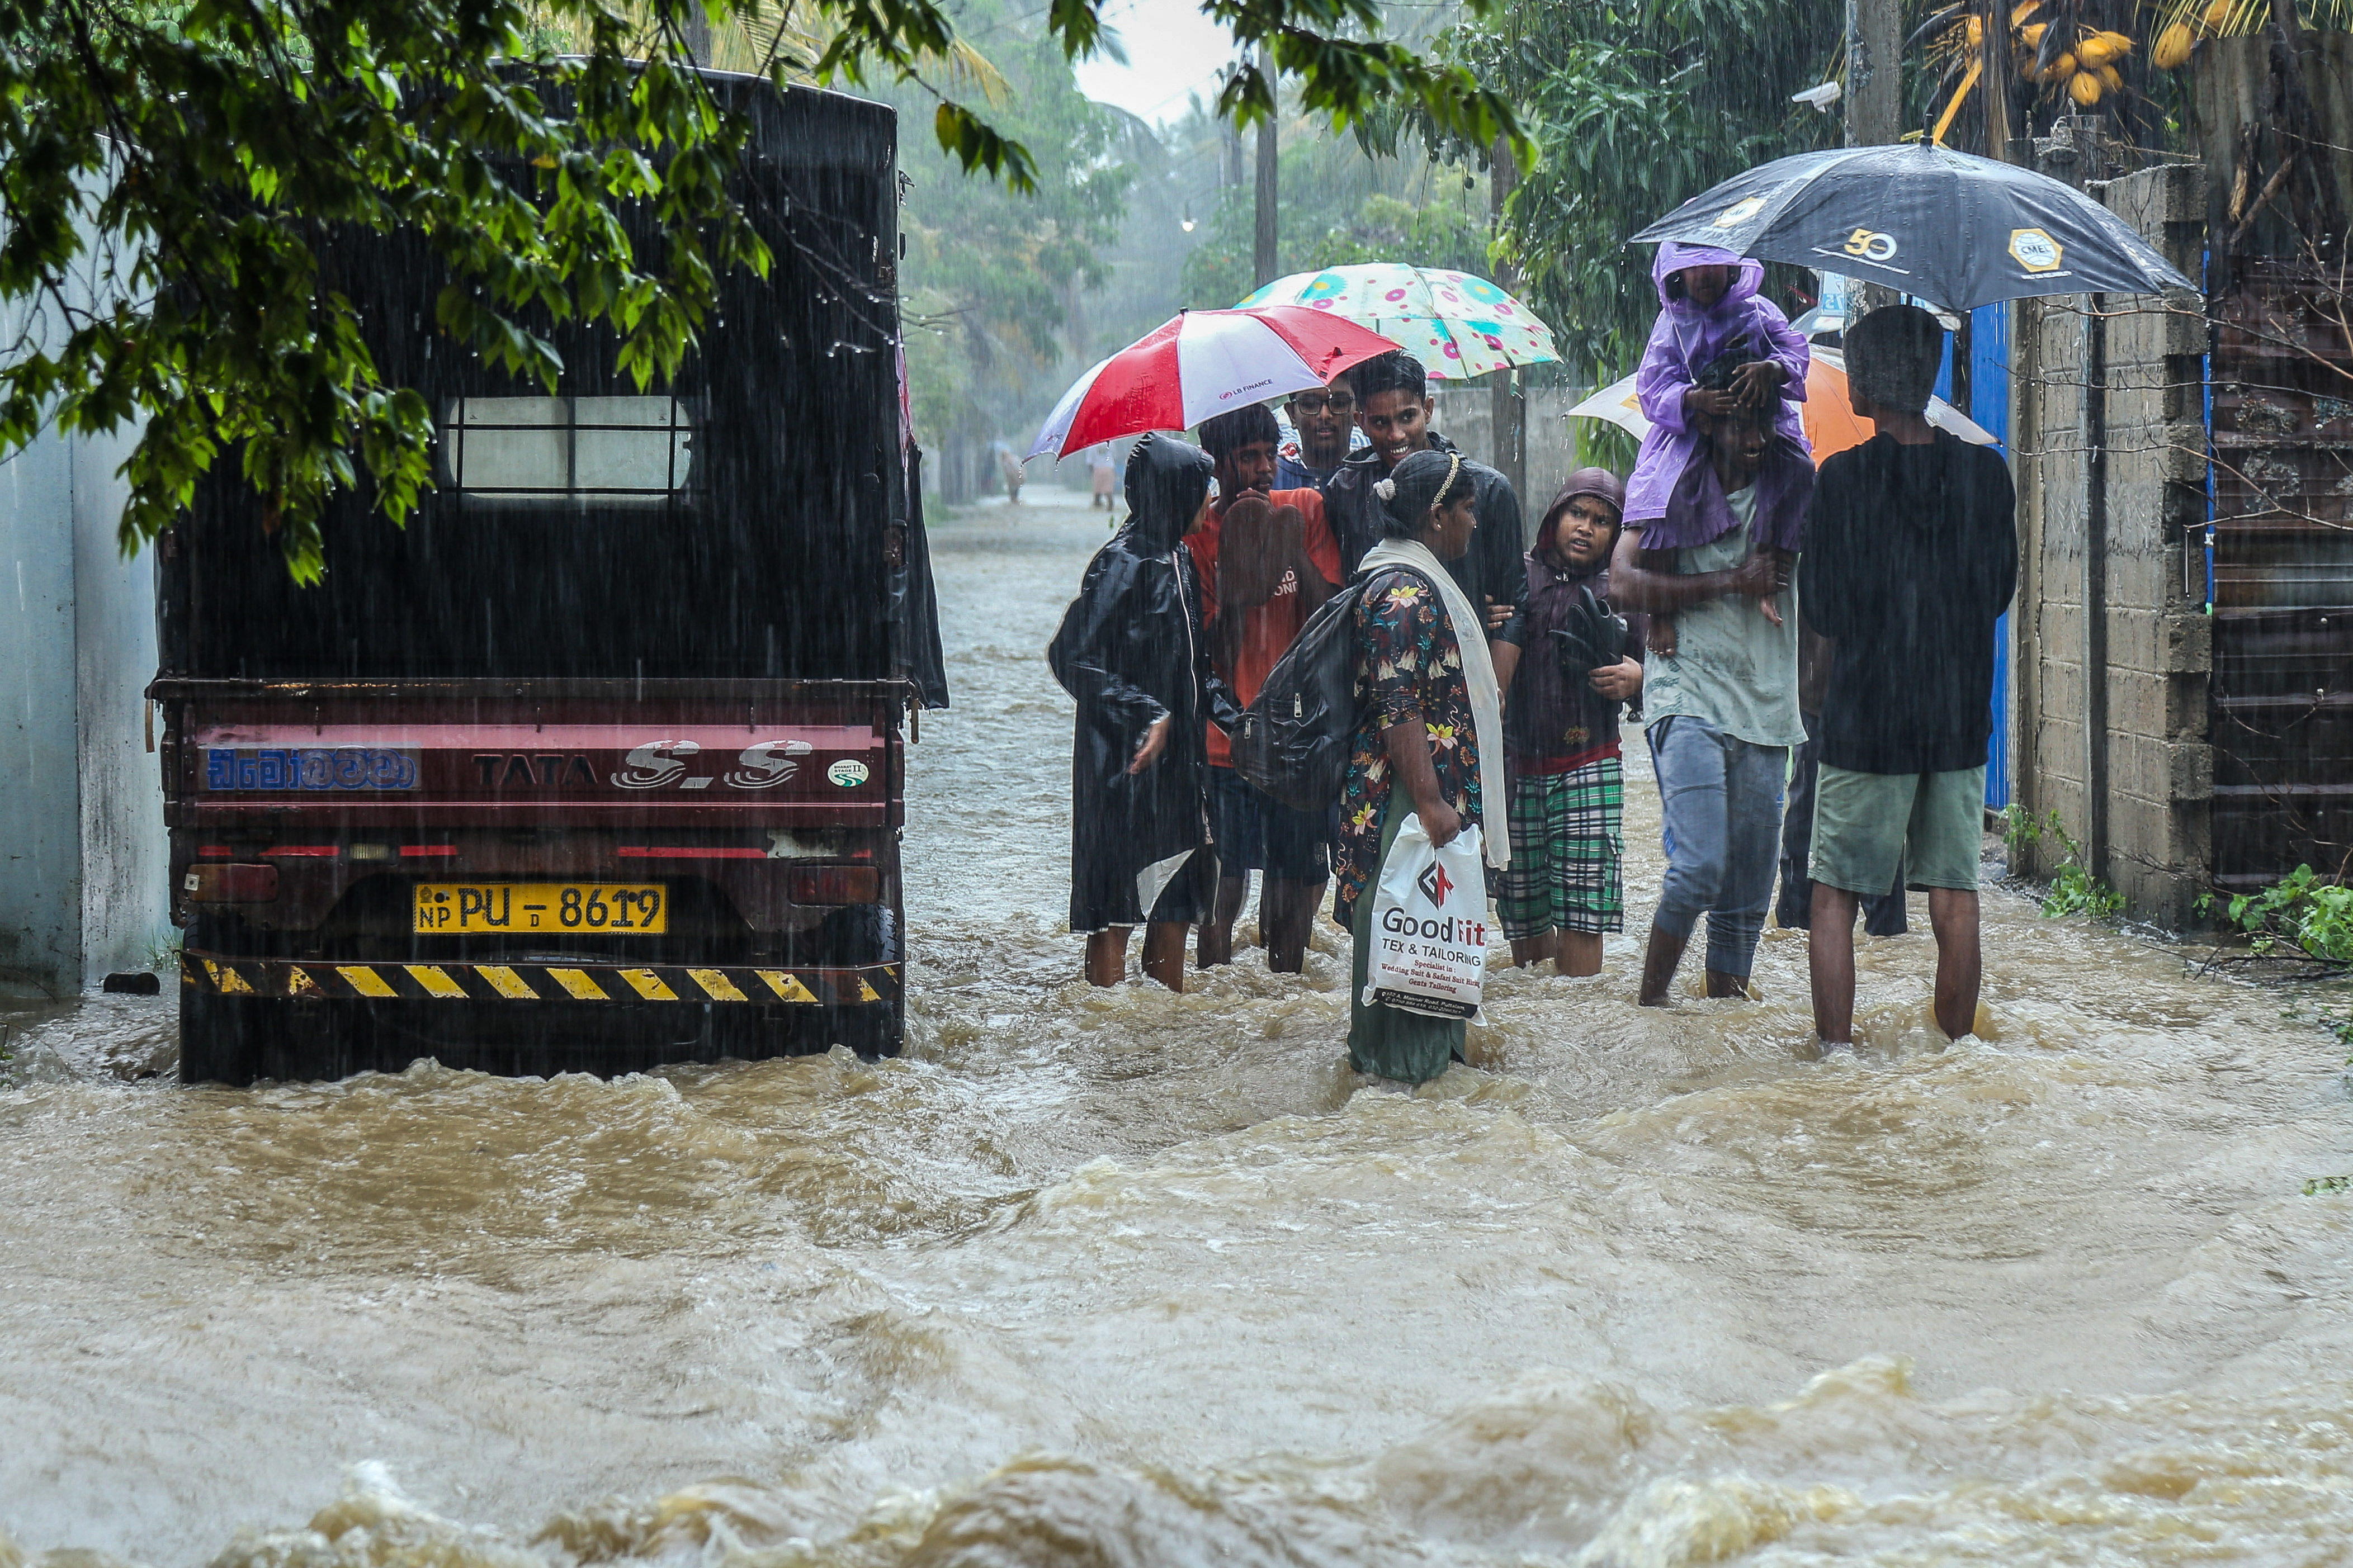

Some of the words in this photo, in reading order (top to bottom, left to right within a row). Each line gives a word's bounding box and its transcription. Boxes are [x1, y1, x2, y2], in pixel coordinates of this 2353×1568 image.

[1844, 228, 1898, 261] 50
[2021, 245, 2051, 254] CMEL
[1242, 378, 1273, 392] FINANCE
[472, 754, 598, 785] TATA
[419, 906, 451, 928] NP
[457, 887, 511, 927] PU
[560, 887, 661, 928] 8619
[530, 913, 540, 927] D
[1382, 907, 1453, 944] Good
[1382, 938, 1405, 954] TEX
[1408, 944, 1418, 955] &
[1422, 945, 1481, 967] TAILORING
[1381, 963, 1409, 975] Wedding
[1411, 969, 1424, 977] Suit
[1432, 973, 1451, 982] Safari
[1452, 976, 1465, 984] Suit
[1414, 960, 1445, 971] Specialist
[1409, 978, 1426, 987] Gents
[1429, 982, 1457, 994] Tailoring
